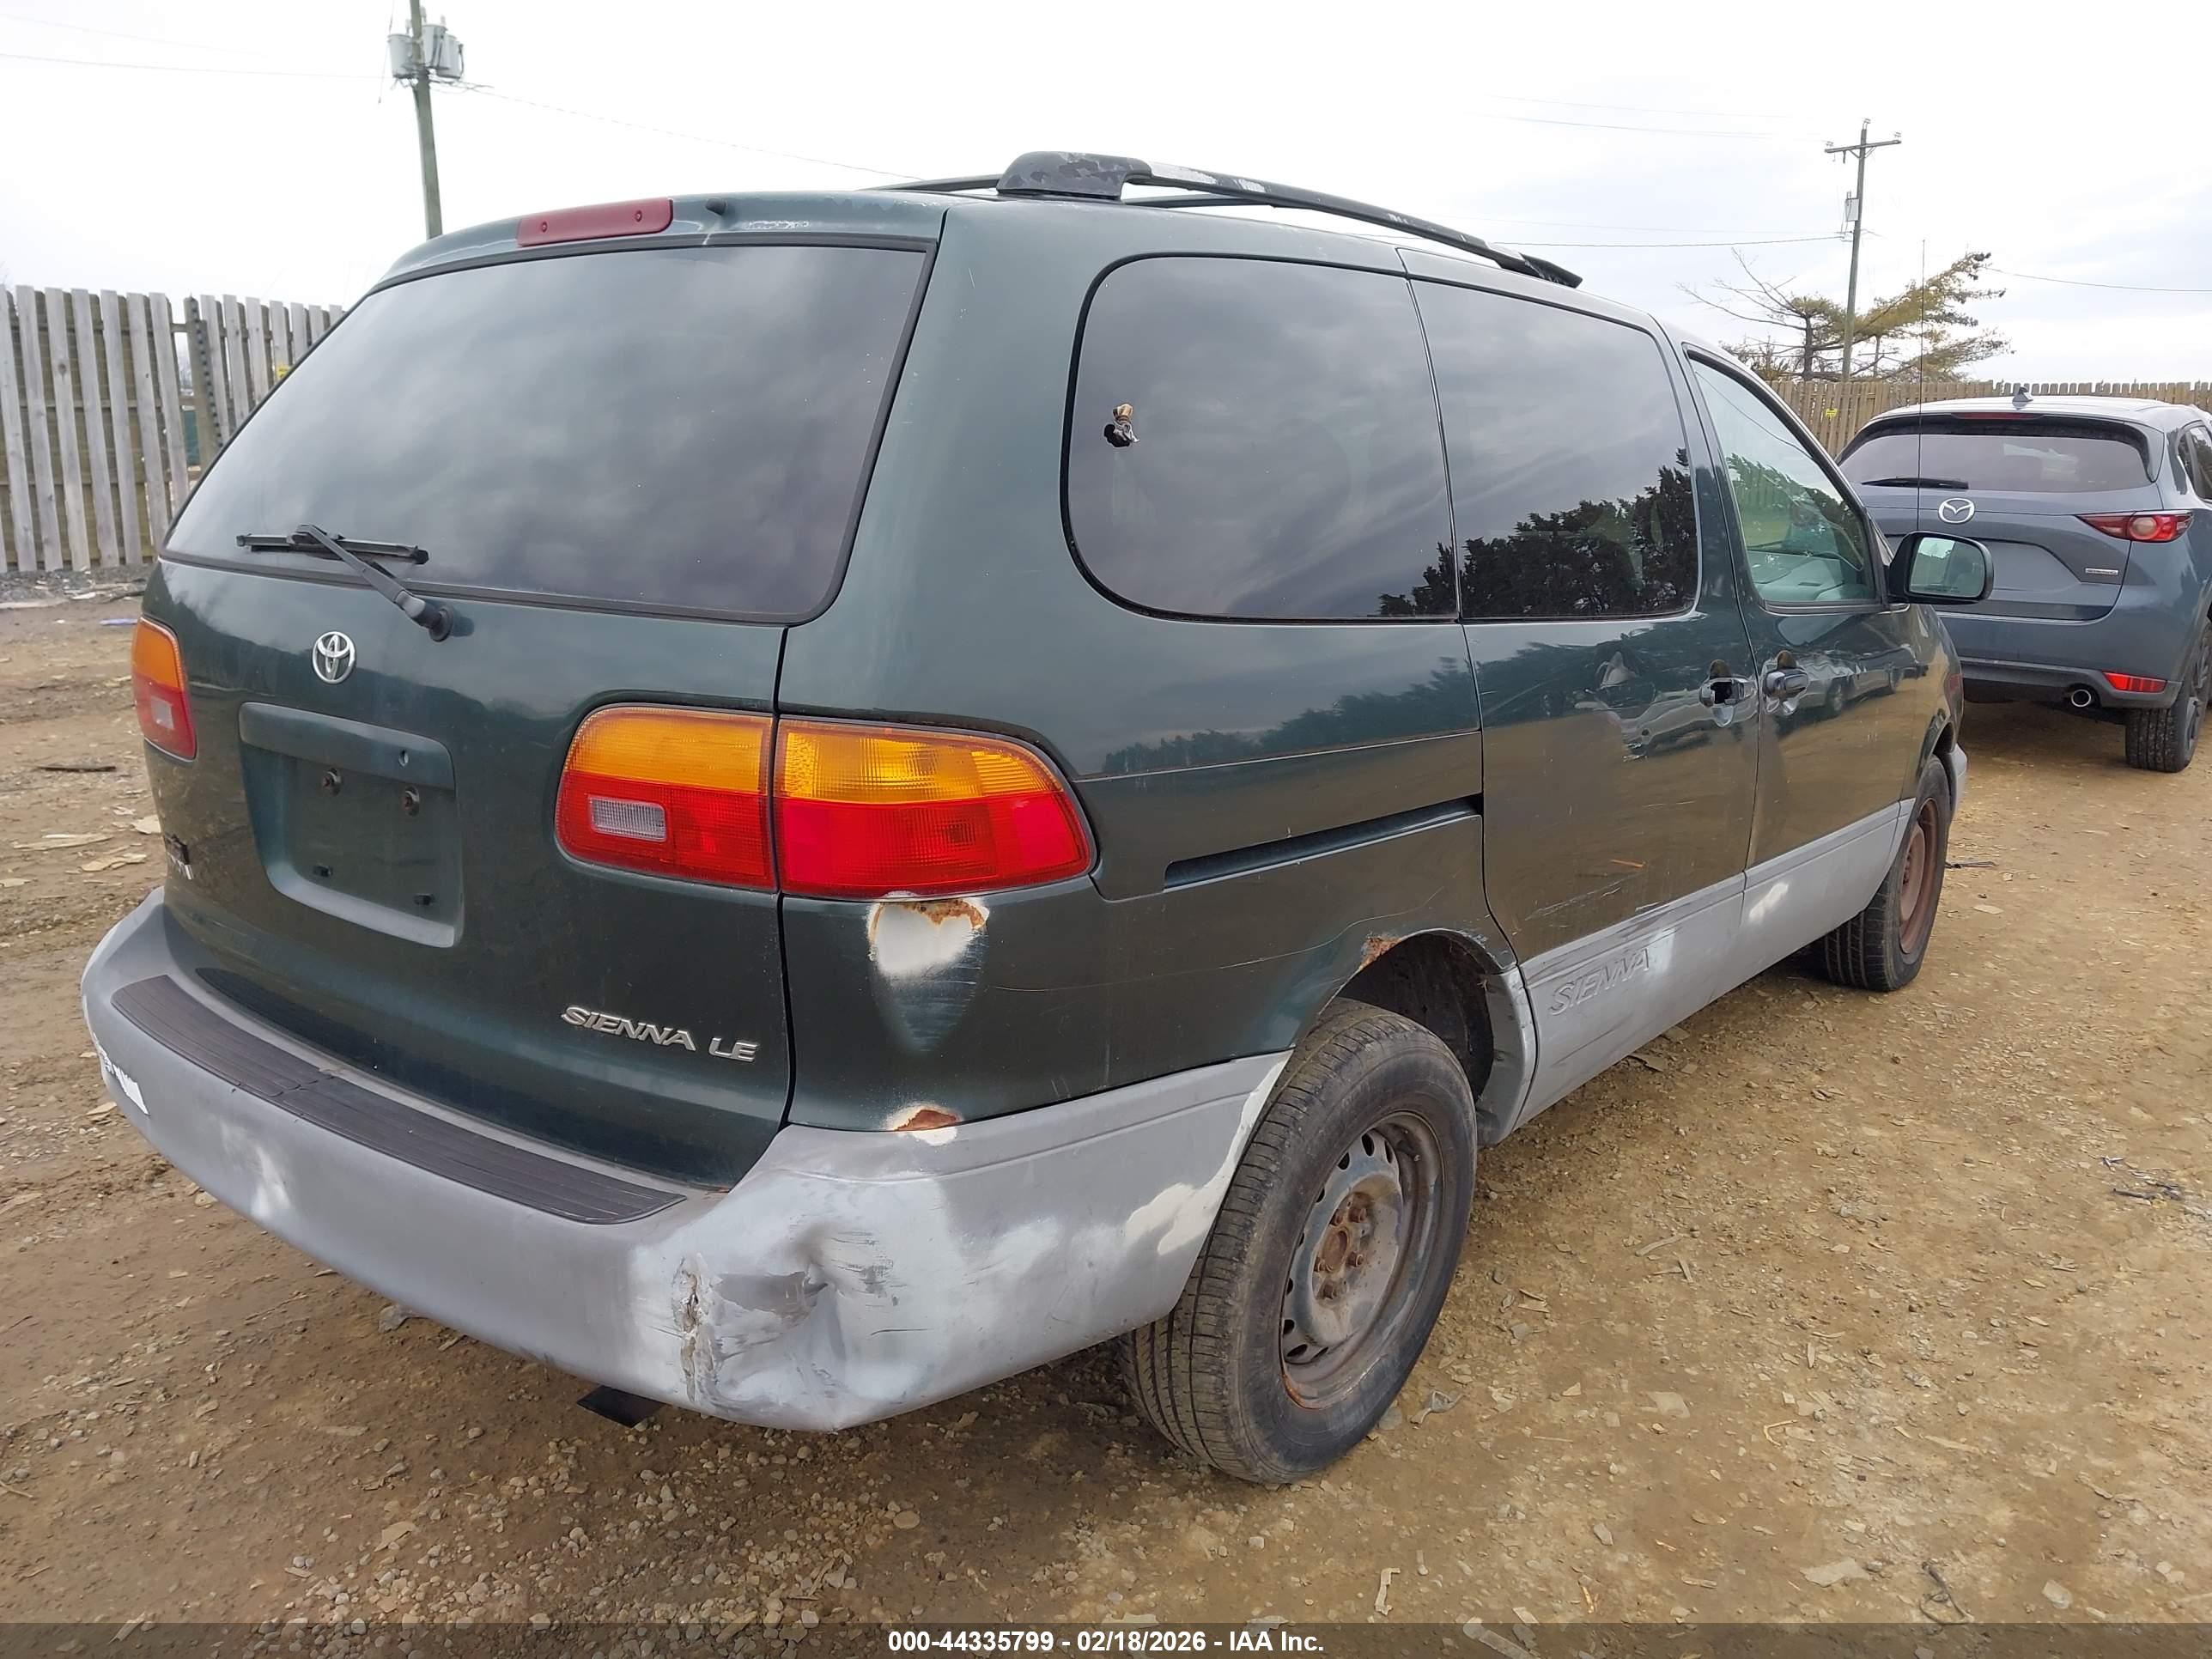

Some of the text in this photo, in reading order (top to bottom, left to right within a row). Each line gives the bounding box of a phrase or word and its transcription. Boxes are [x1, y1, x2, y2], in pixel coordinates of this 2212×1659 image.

[1549, 948, 1649, 1016] SIENNA
[561, 1006, 759, 1062] SIENNA LE
